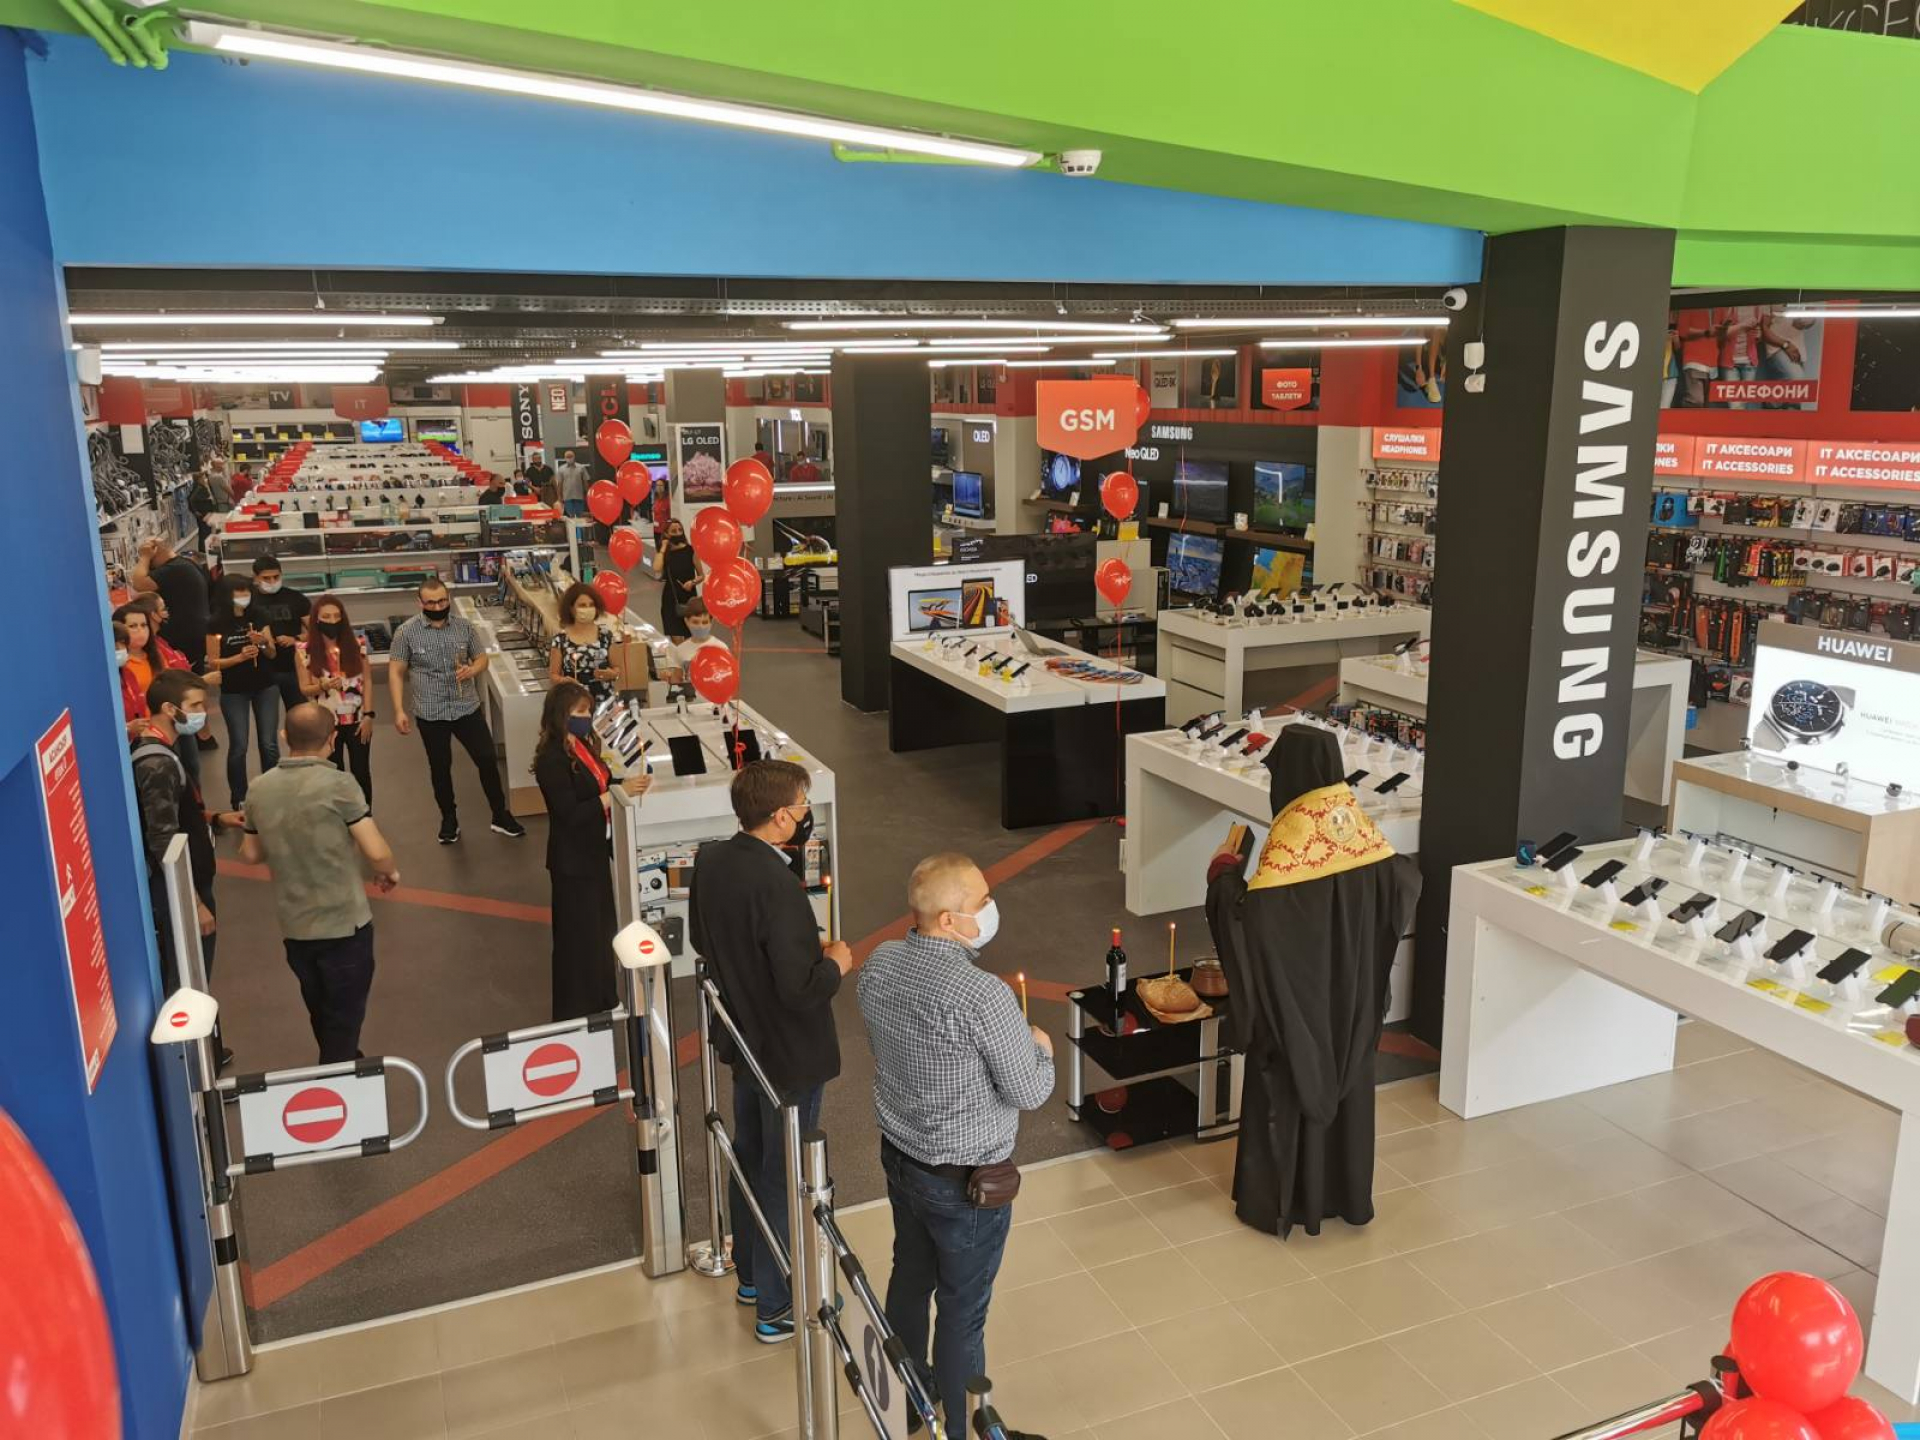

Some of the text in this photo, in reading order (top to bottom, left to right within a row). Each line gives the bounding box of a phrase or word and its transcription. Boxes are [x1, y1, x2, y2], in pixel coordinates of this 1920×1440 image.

[1277, 380, 1297, 389] ФОТО
[1716, 384, 1810, 399] ТЕЛЕФОНИ
[270, 391, 290, 402] TV
[1271, 392, 1302, 401] ТАБЛЕТИ
[517, 384, 534, 439] SONY
[1059, 409, 1115, 432] GSM
[973, 430, 990, 443] OLED
[1151, 425, 1193, 440] SAMSUNG
[1384, 433, 1425, 444] СЛУШАЛКИ
[682, 436, 719, 445] LG OLED
[1125, 446, 1160, 461] Neo QLED
[1381, 444, 1428, 456] HEADPHONES
[1706, 443, 1793, 457] IT АКСЕСОАРИ
[1820, 448, 1920, 464] IT АКСЕСОАРИ
[1702, 460, 1794, 475] IT ACCESSORIES
[1815, 465, 1920, 482] IT ACCESSORIES
[1553, 320, 1640, 760] SAMSUNG
[1817, 636, 1893, 663] HUAWEI
[1860, 712, 1892, 725] HUAWEI
